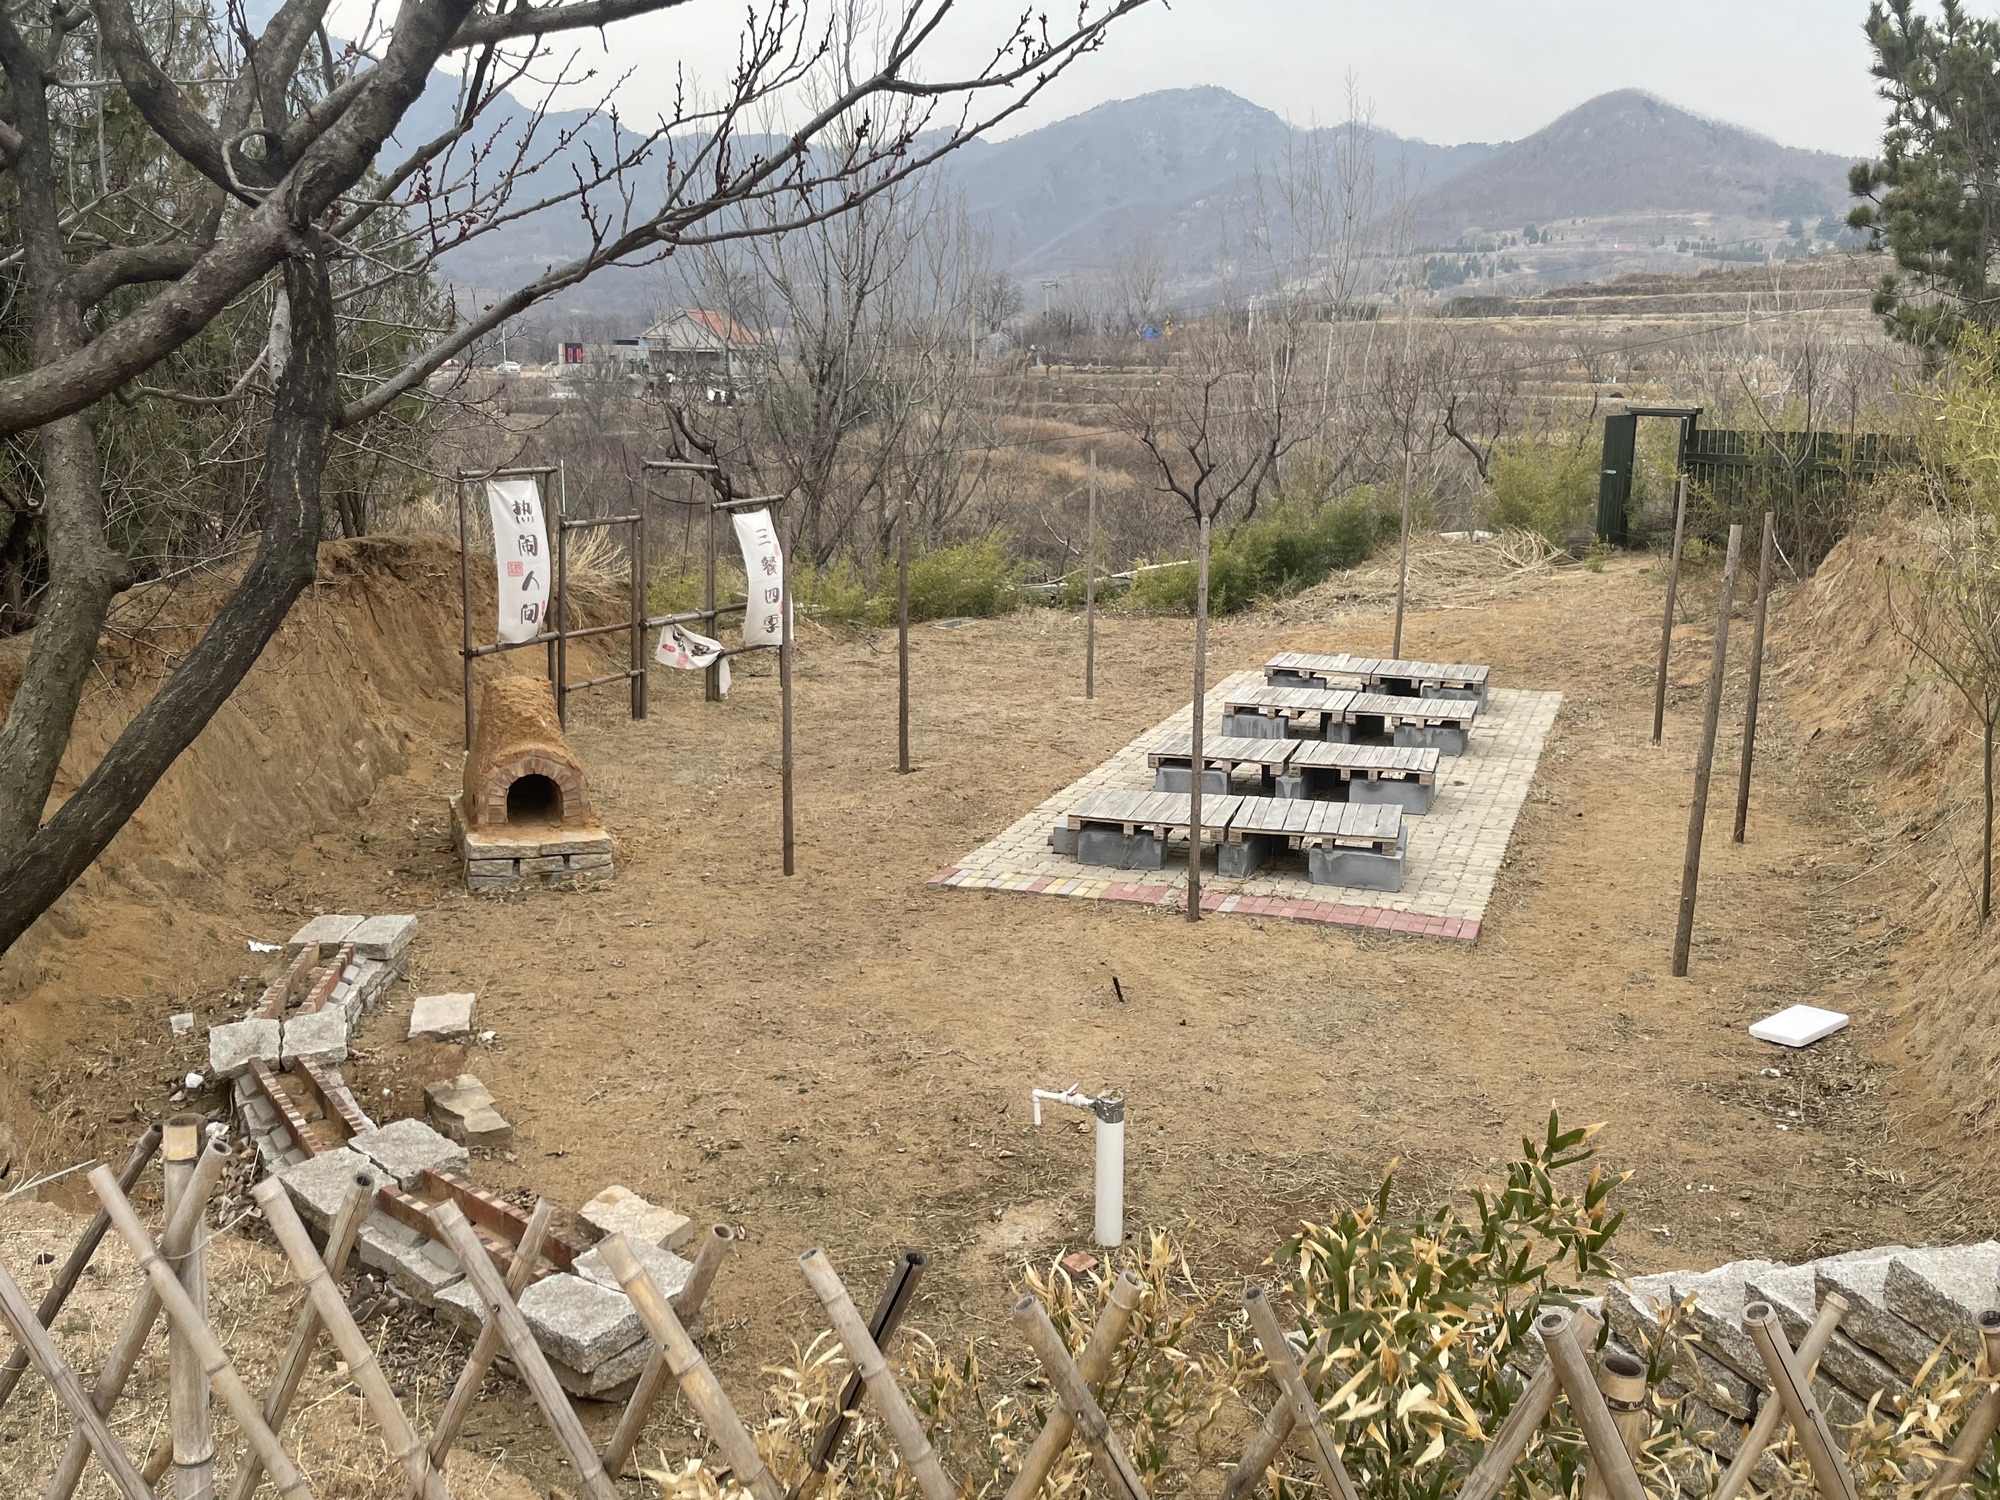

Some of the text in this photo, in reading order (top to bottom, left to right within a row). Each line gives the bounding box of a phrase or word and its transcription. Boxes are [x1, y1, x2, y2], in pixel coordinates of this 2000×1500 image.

[512, 500, 540, 625] 热闹人间
[756, 528, 780, 634] 三餐四季
